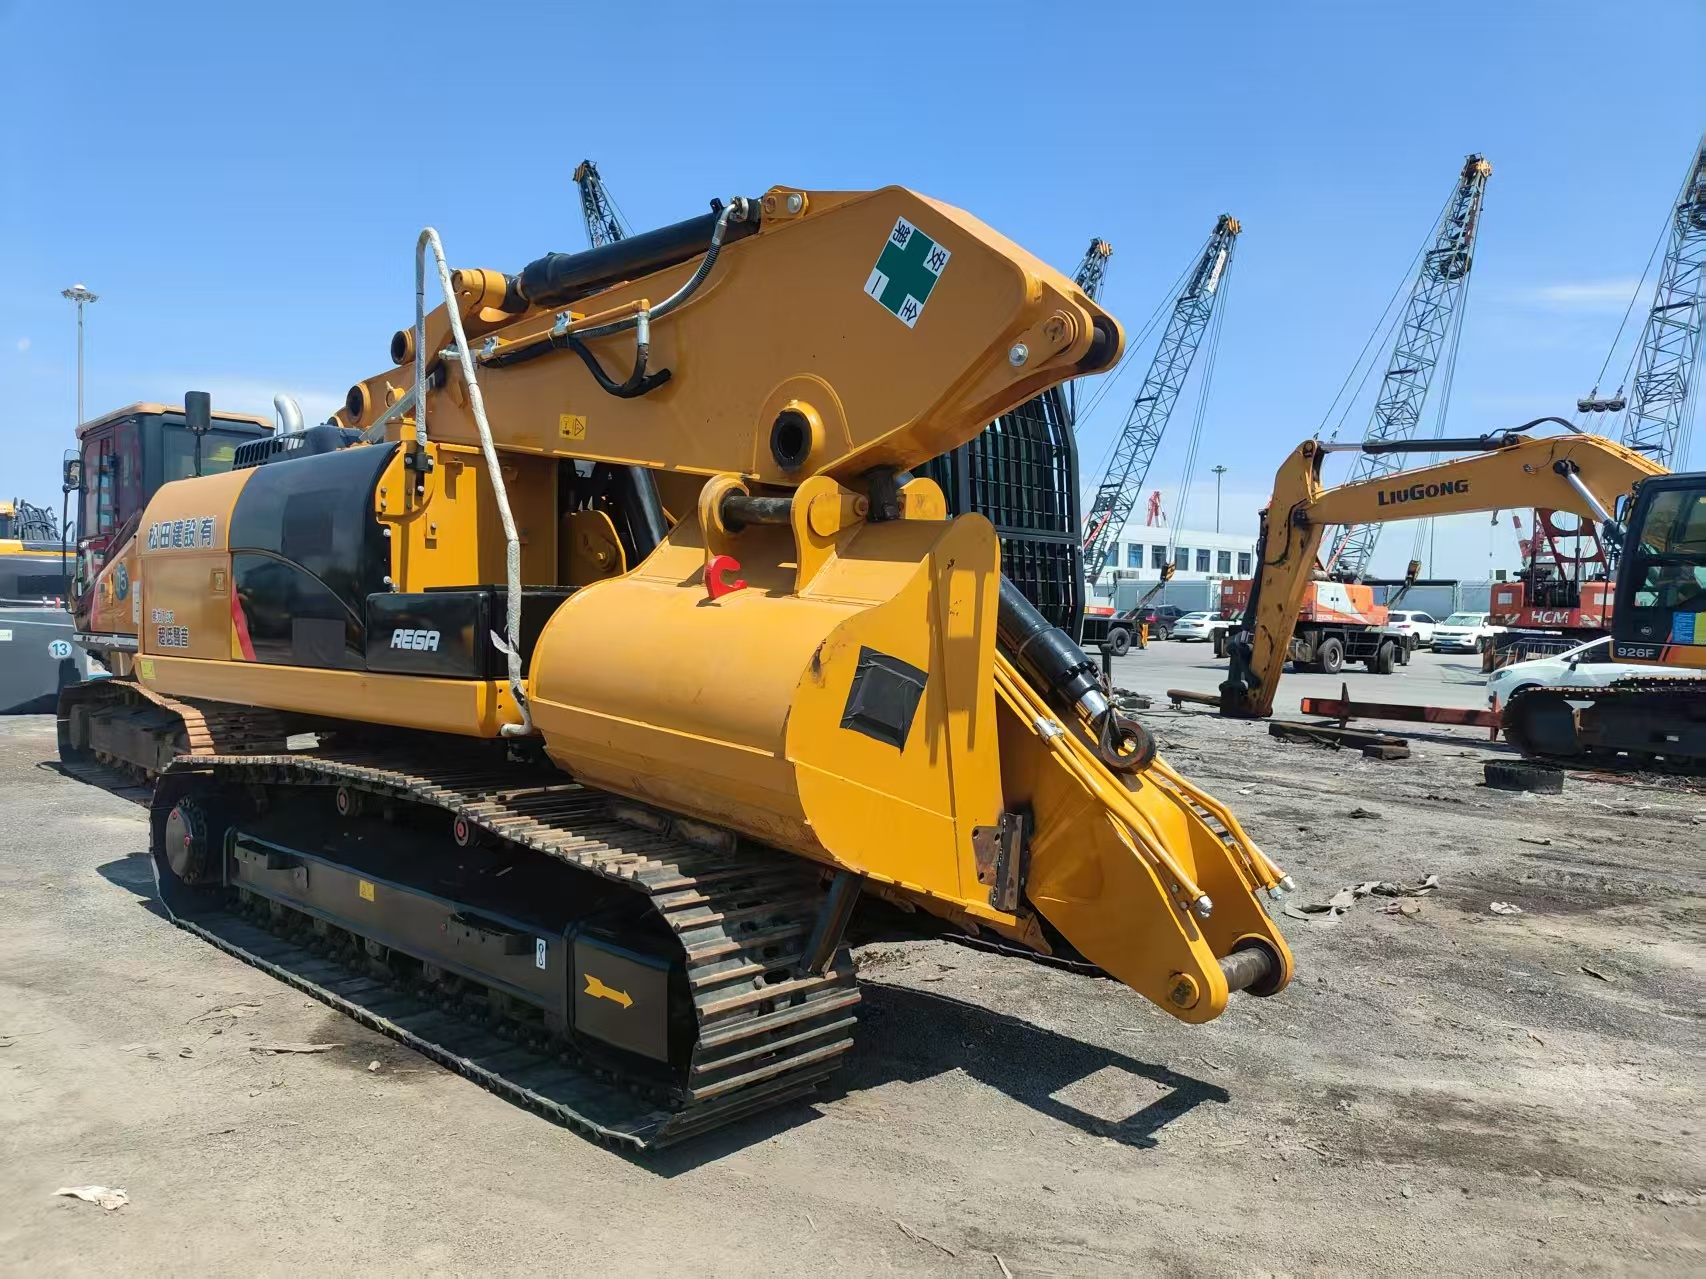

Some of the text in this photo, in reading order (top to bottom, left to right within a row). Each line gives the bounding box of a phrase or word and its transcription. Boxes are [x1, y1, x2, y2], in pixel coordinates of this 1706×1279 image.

[1531, 610, 1569, 624] HCM
[52, 642, 68, 656] 13
[1617, 647, 1656, 659] 926F
